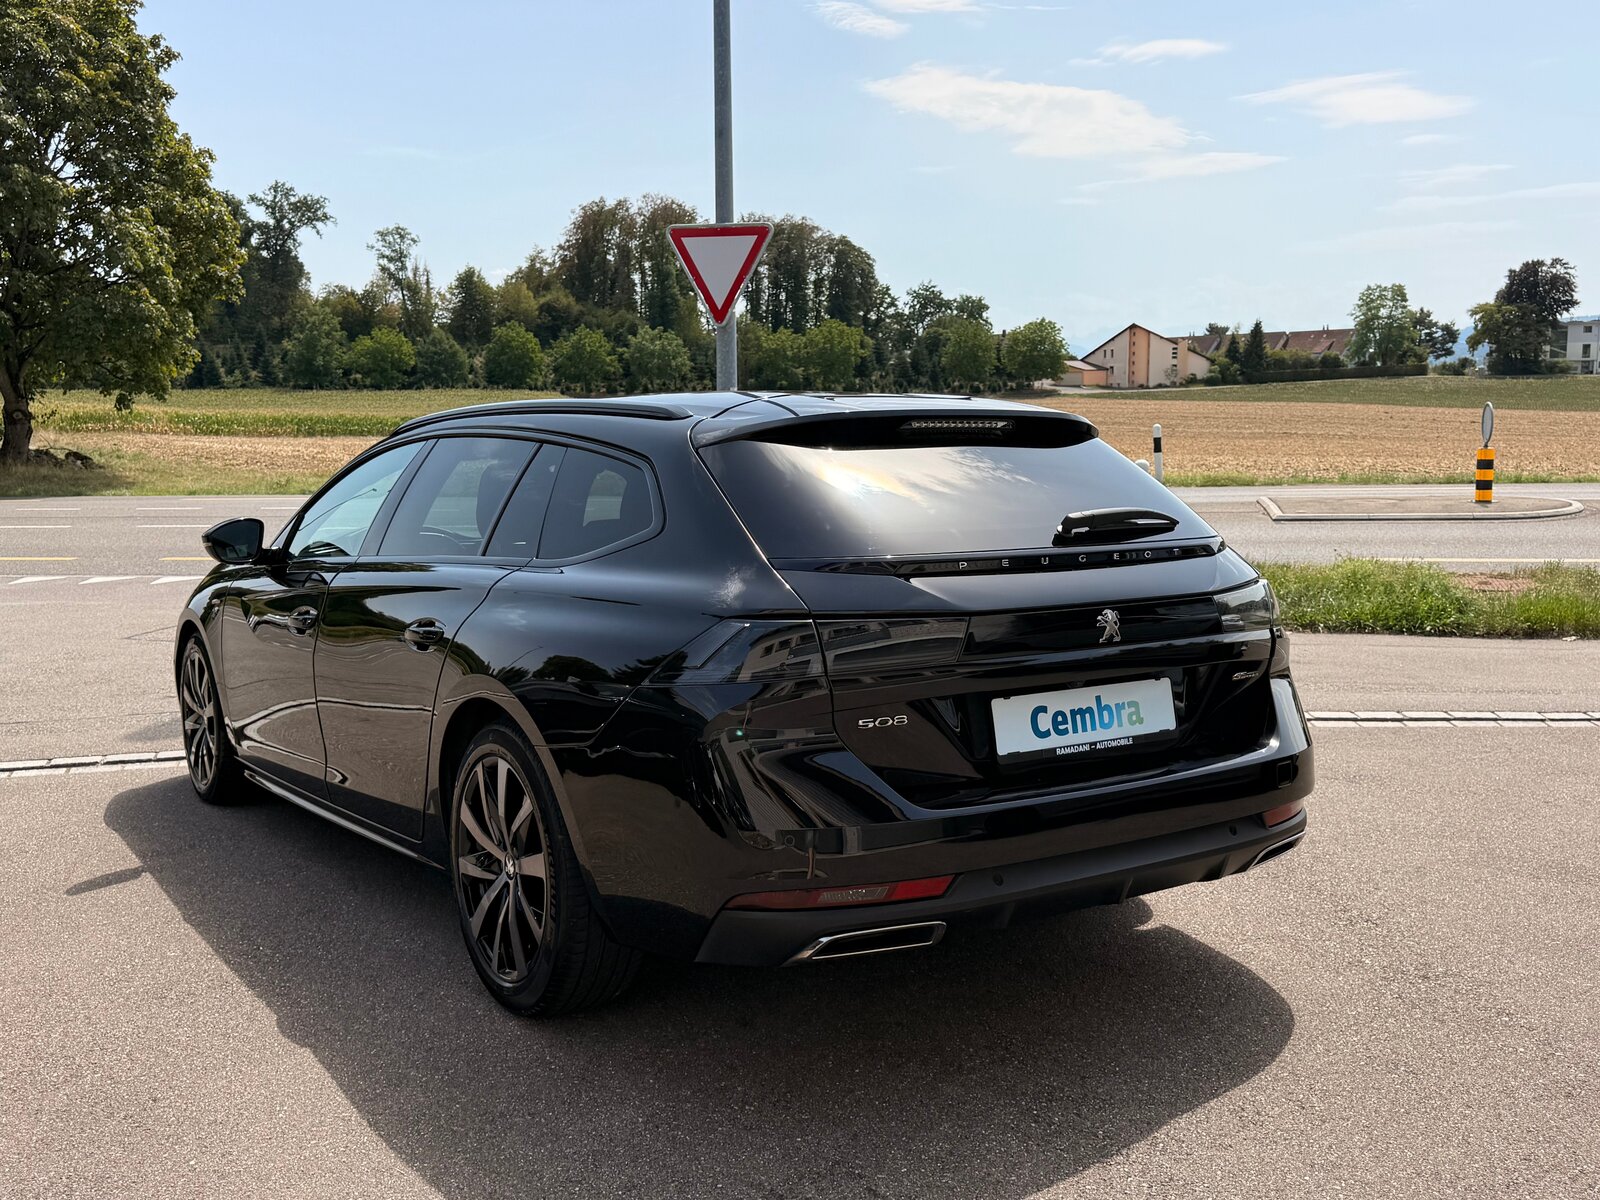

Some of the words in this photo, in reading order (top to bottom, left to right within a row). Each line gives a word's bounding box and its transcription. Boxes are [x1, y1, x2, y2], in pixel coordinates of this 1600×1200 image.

[958, 548, 1180, 570] PEUGEOT
[857, 715, 908, 729] 508
[1031, 695, 1144, 739] Cembra
[1056, 744, 1090, 755] RAMADANI
[1096, 738, 1133, 749] AUTOMOBILE
